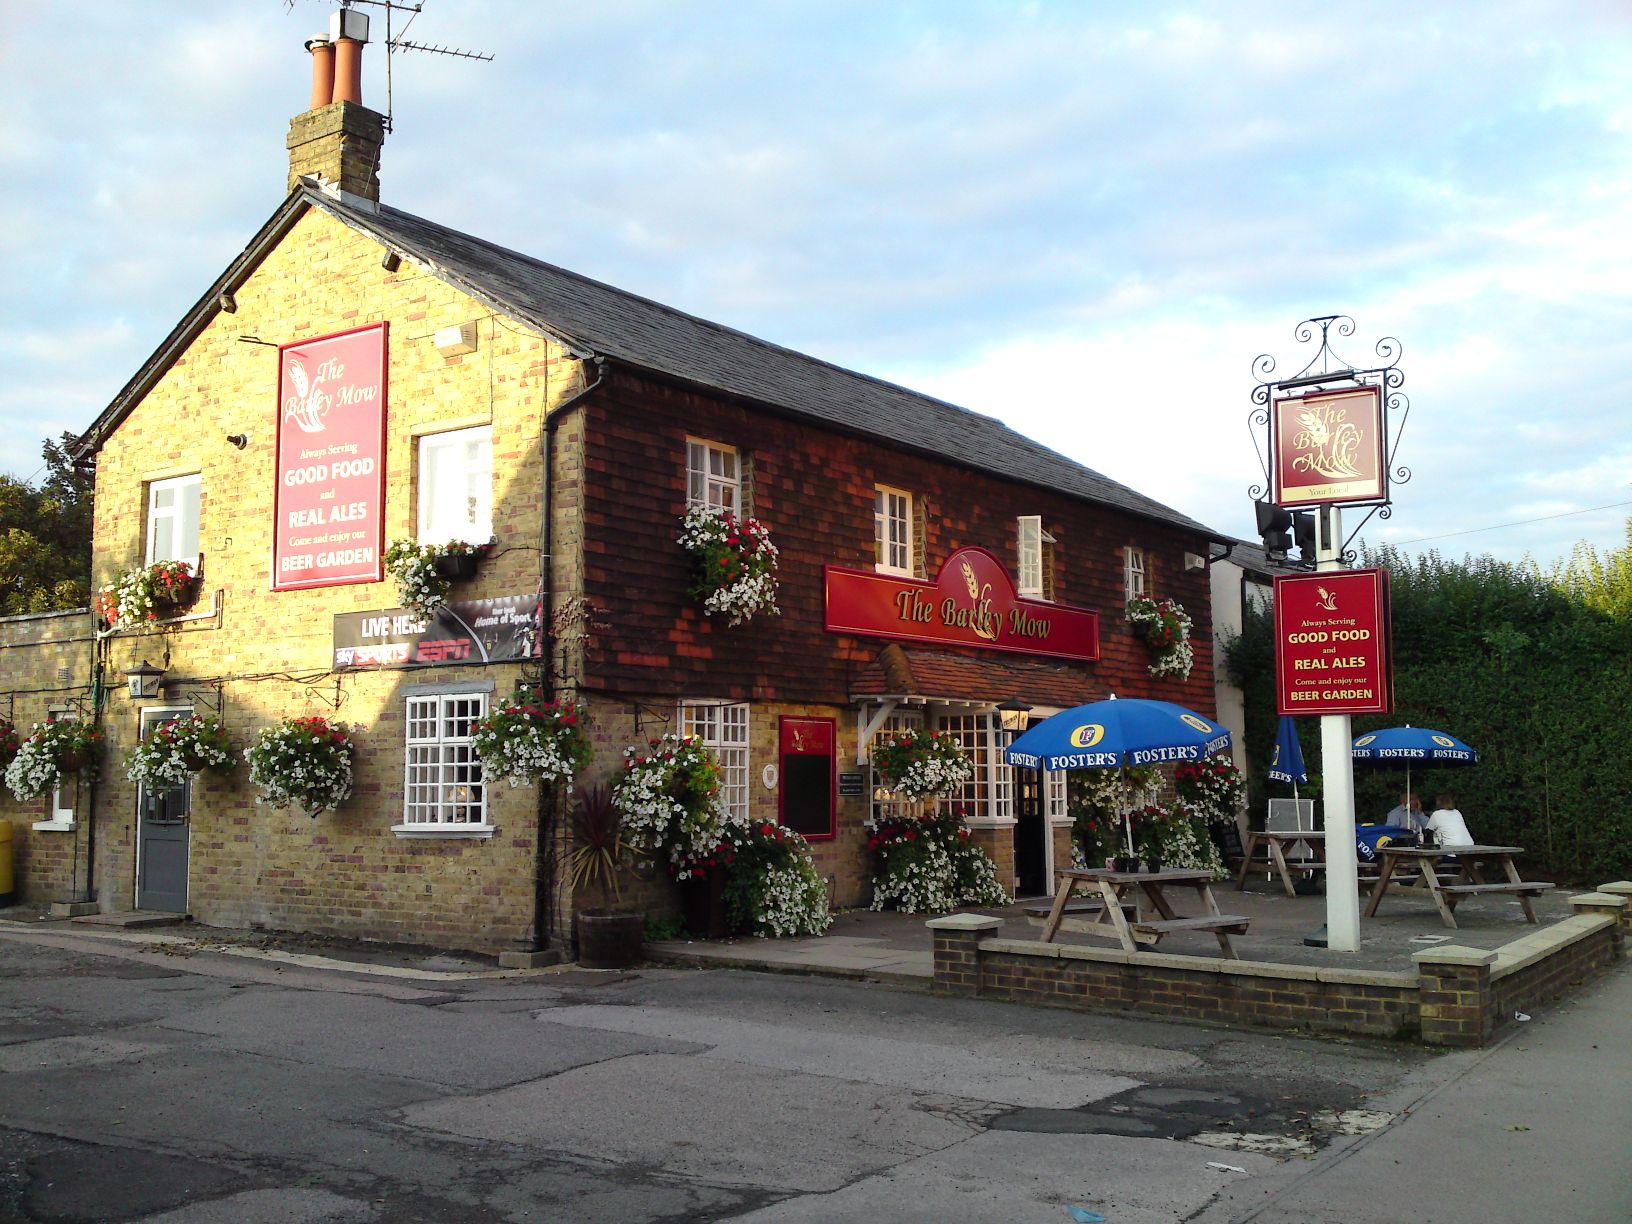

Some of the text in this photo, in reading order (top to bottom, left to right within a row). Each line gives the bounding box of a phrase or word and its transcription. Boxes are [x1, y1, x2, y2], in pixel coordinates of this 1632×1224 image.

[317, 357, 345, 383] The
[285, 384, 377, 416] Barley Mow
[1309, 402, 1346, 423] The
[300, 443, 358, 460] Always Serving
[1293, 424, 1364, 473] Barley Mow
[285, 457, 374, 487] GOOD FOOD
[320, 488, 335, 500] and
[289, 502, 367, 528] REAL ALES
[289, 531, 367, 547] Come and enjoy our
[281, 547, 373, 572] BEER GARDEN
[474, 612, 531, 628] Home of Sport
[896, 588, 1051, 642] The Barley Mow
[1301, 618, 1356, 628] Always Serving
[361, 616, 390, 638] LIVE
[1288, 629, 1370, 644] GOOD FOOD
[336, 646, 408, 666] sky SPORTS
[416, 639, 470, 662] ESPN
[1294, 656, 1366, 670] REAL ALES
[1295, 678, 1317, 686] Come
[1333, 677, 1353, 686] enjoy
[1290, 689, 1373, 701] BEER GARDEN
[1050, 752, 1117, 770] FOSTER'S
[1133, 745, 1198, 764] FOSTER'S
[1380, 748, 1425, 758] FOSTER'S
[1433, 749, 1470, 760] FOSTER'S
